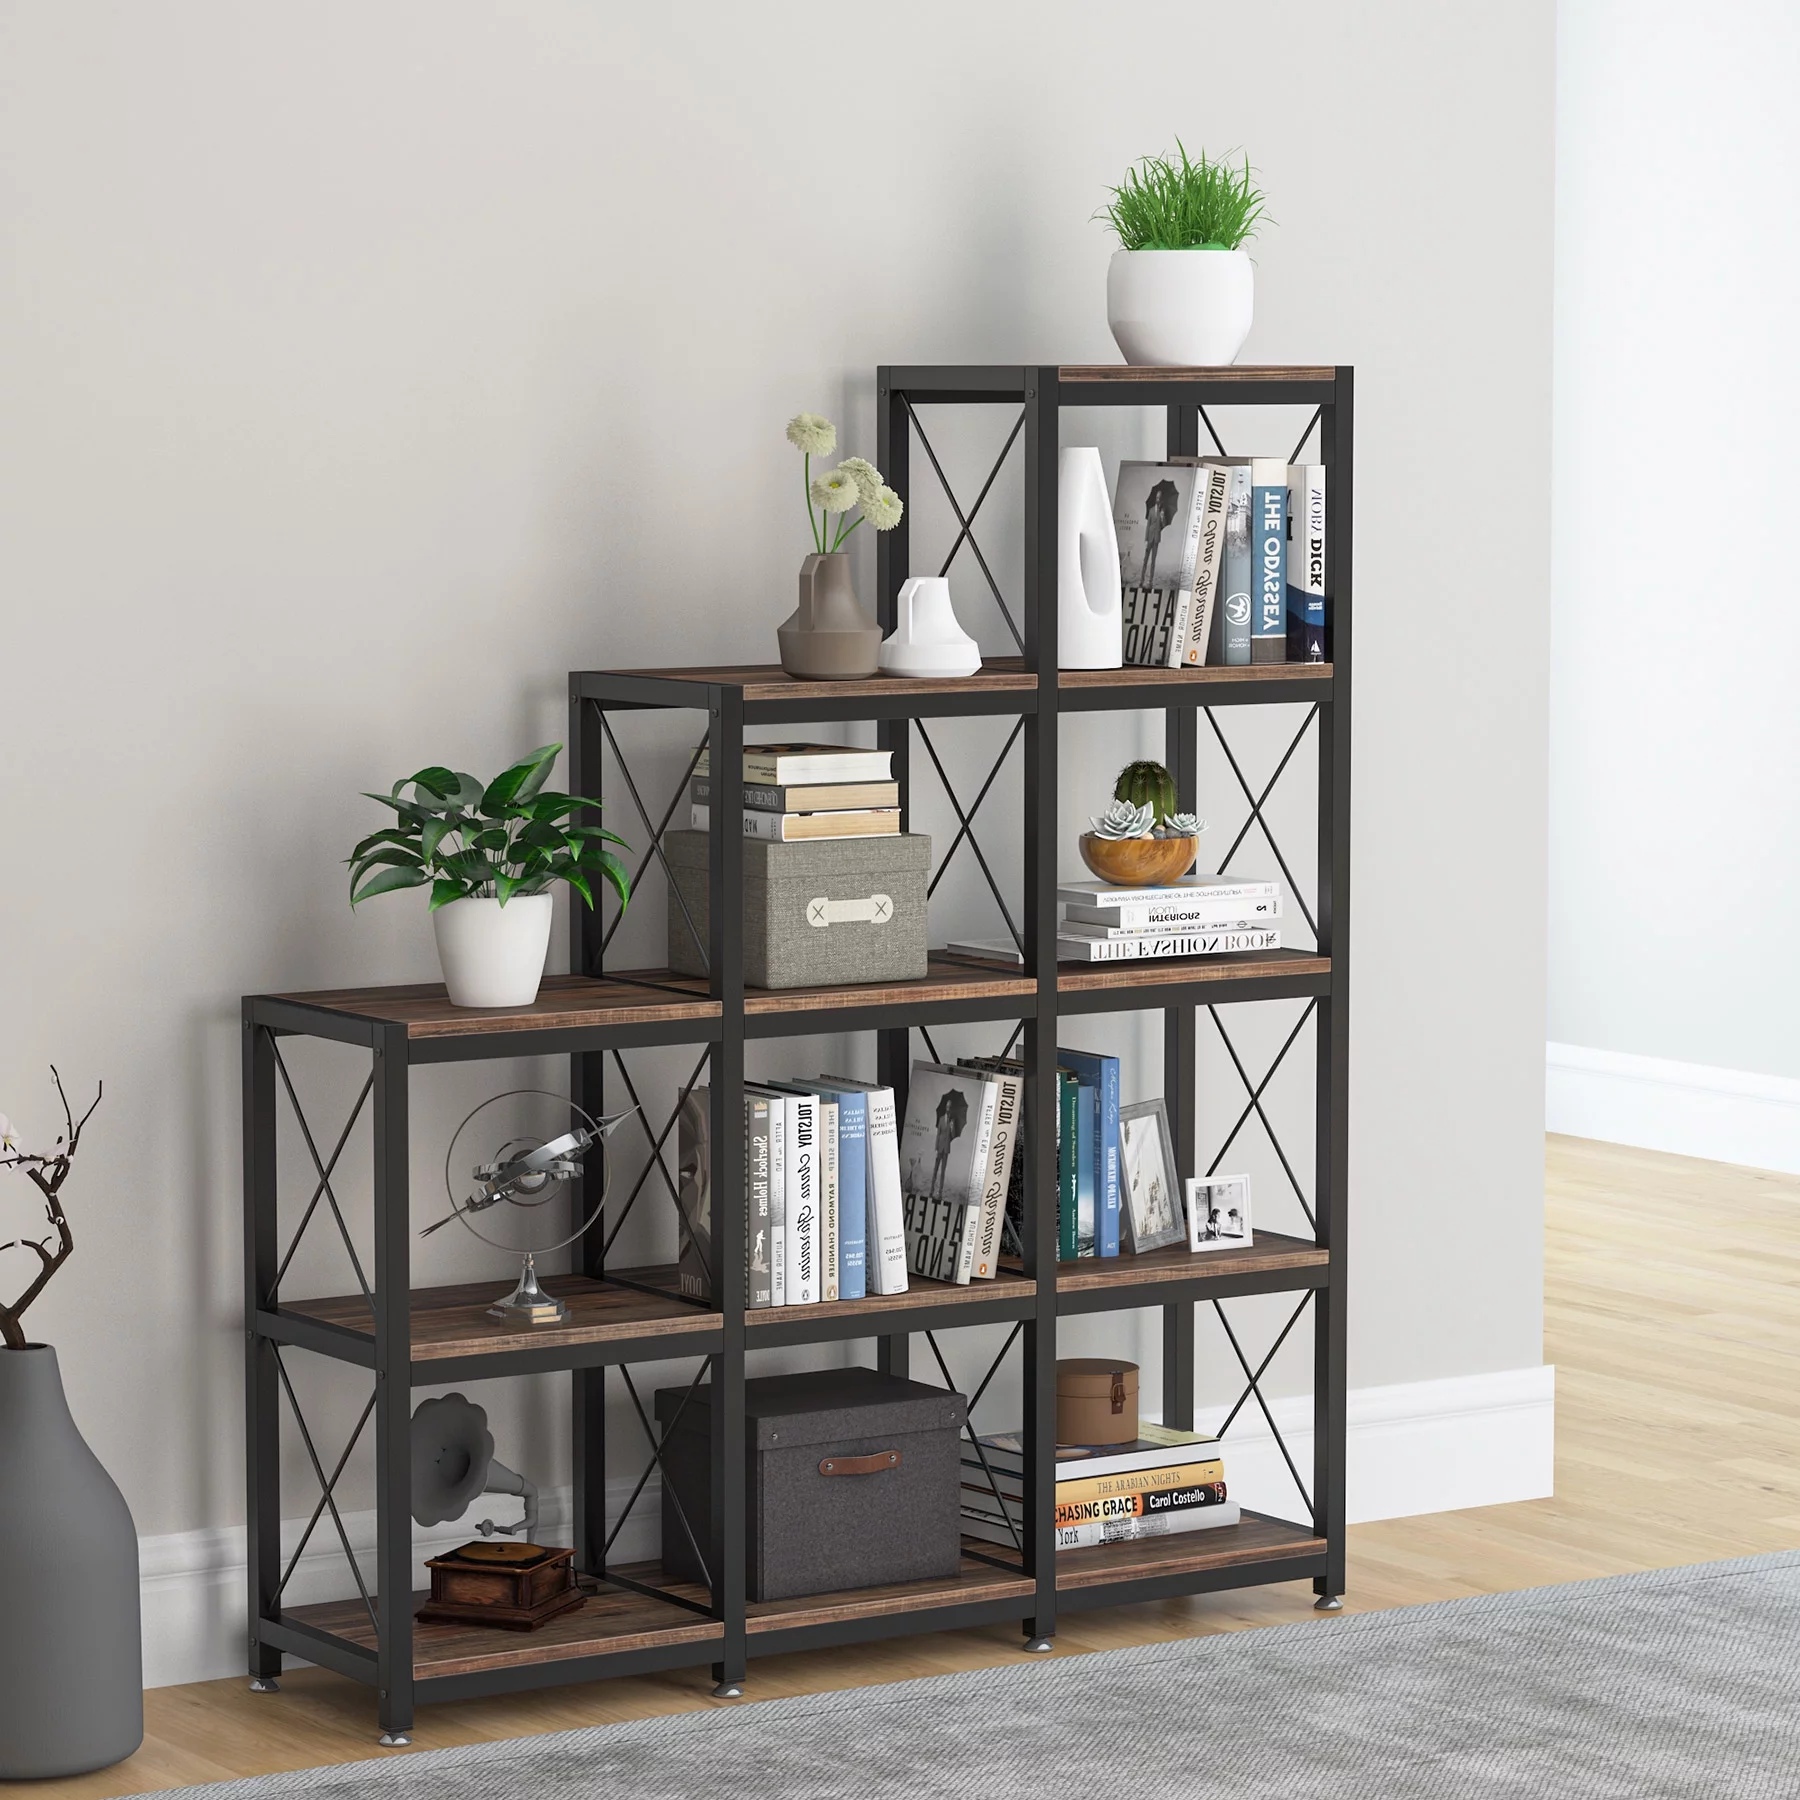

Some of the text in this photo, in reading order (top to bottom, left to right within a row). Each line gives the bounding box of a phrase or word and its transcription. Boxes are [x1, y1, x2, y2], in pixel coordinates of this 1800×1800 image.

[1097, 1471, 1181, 1494] THE ARABIAN NIGHTS
[1102, 1496, 1138, 1516] GRACE
[1149, 1493, 1171, 1509] Carol
[1172, 1489, 1206, 1505] Costello
[1057, 1526, 1079, 1545] York
